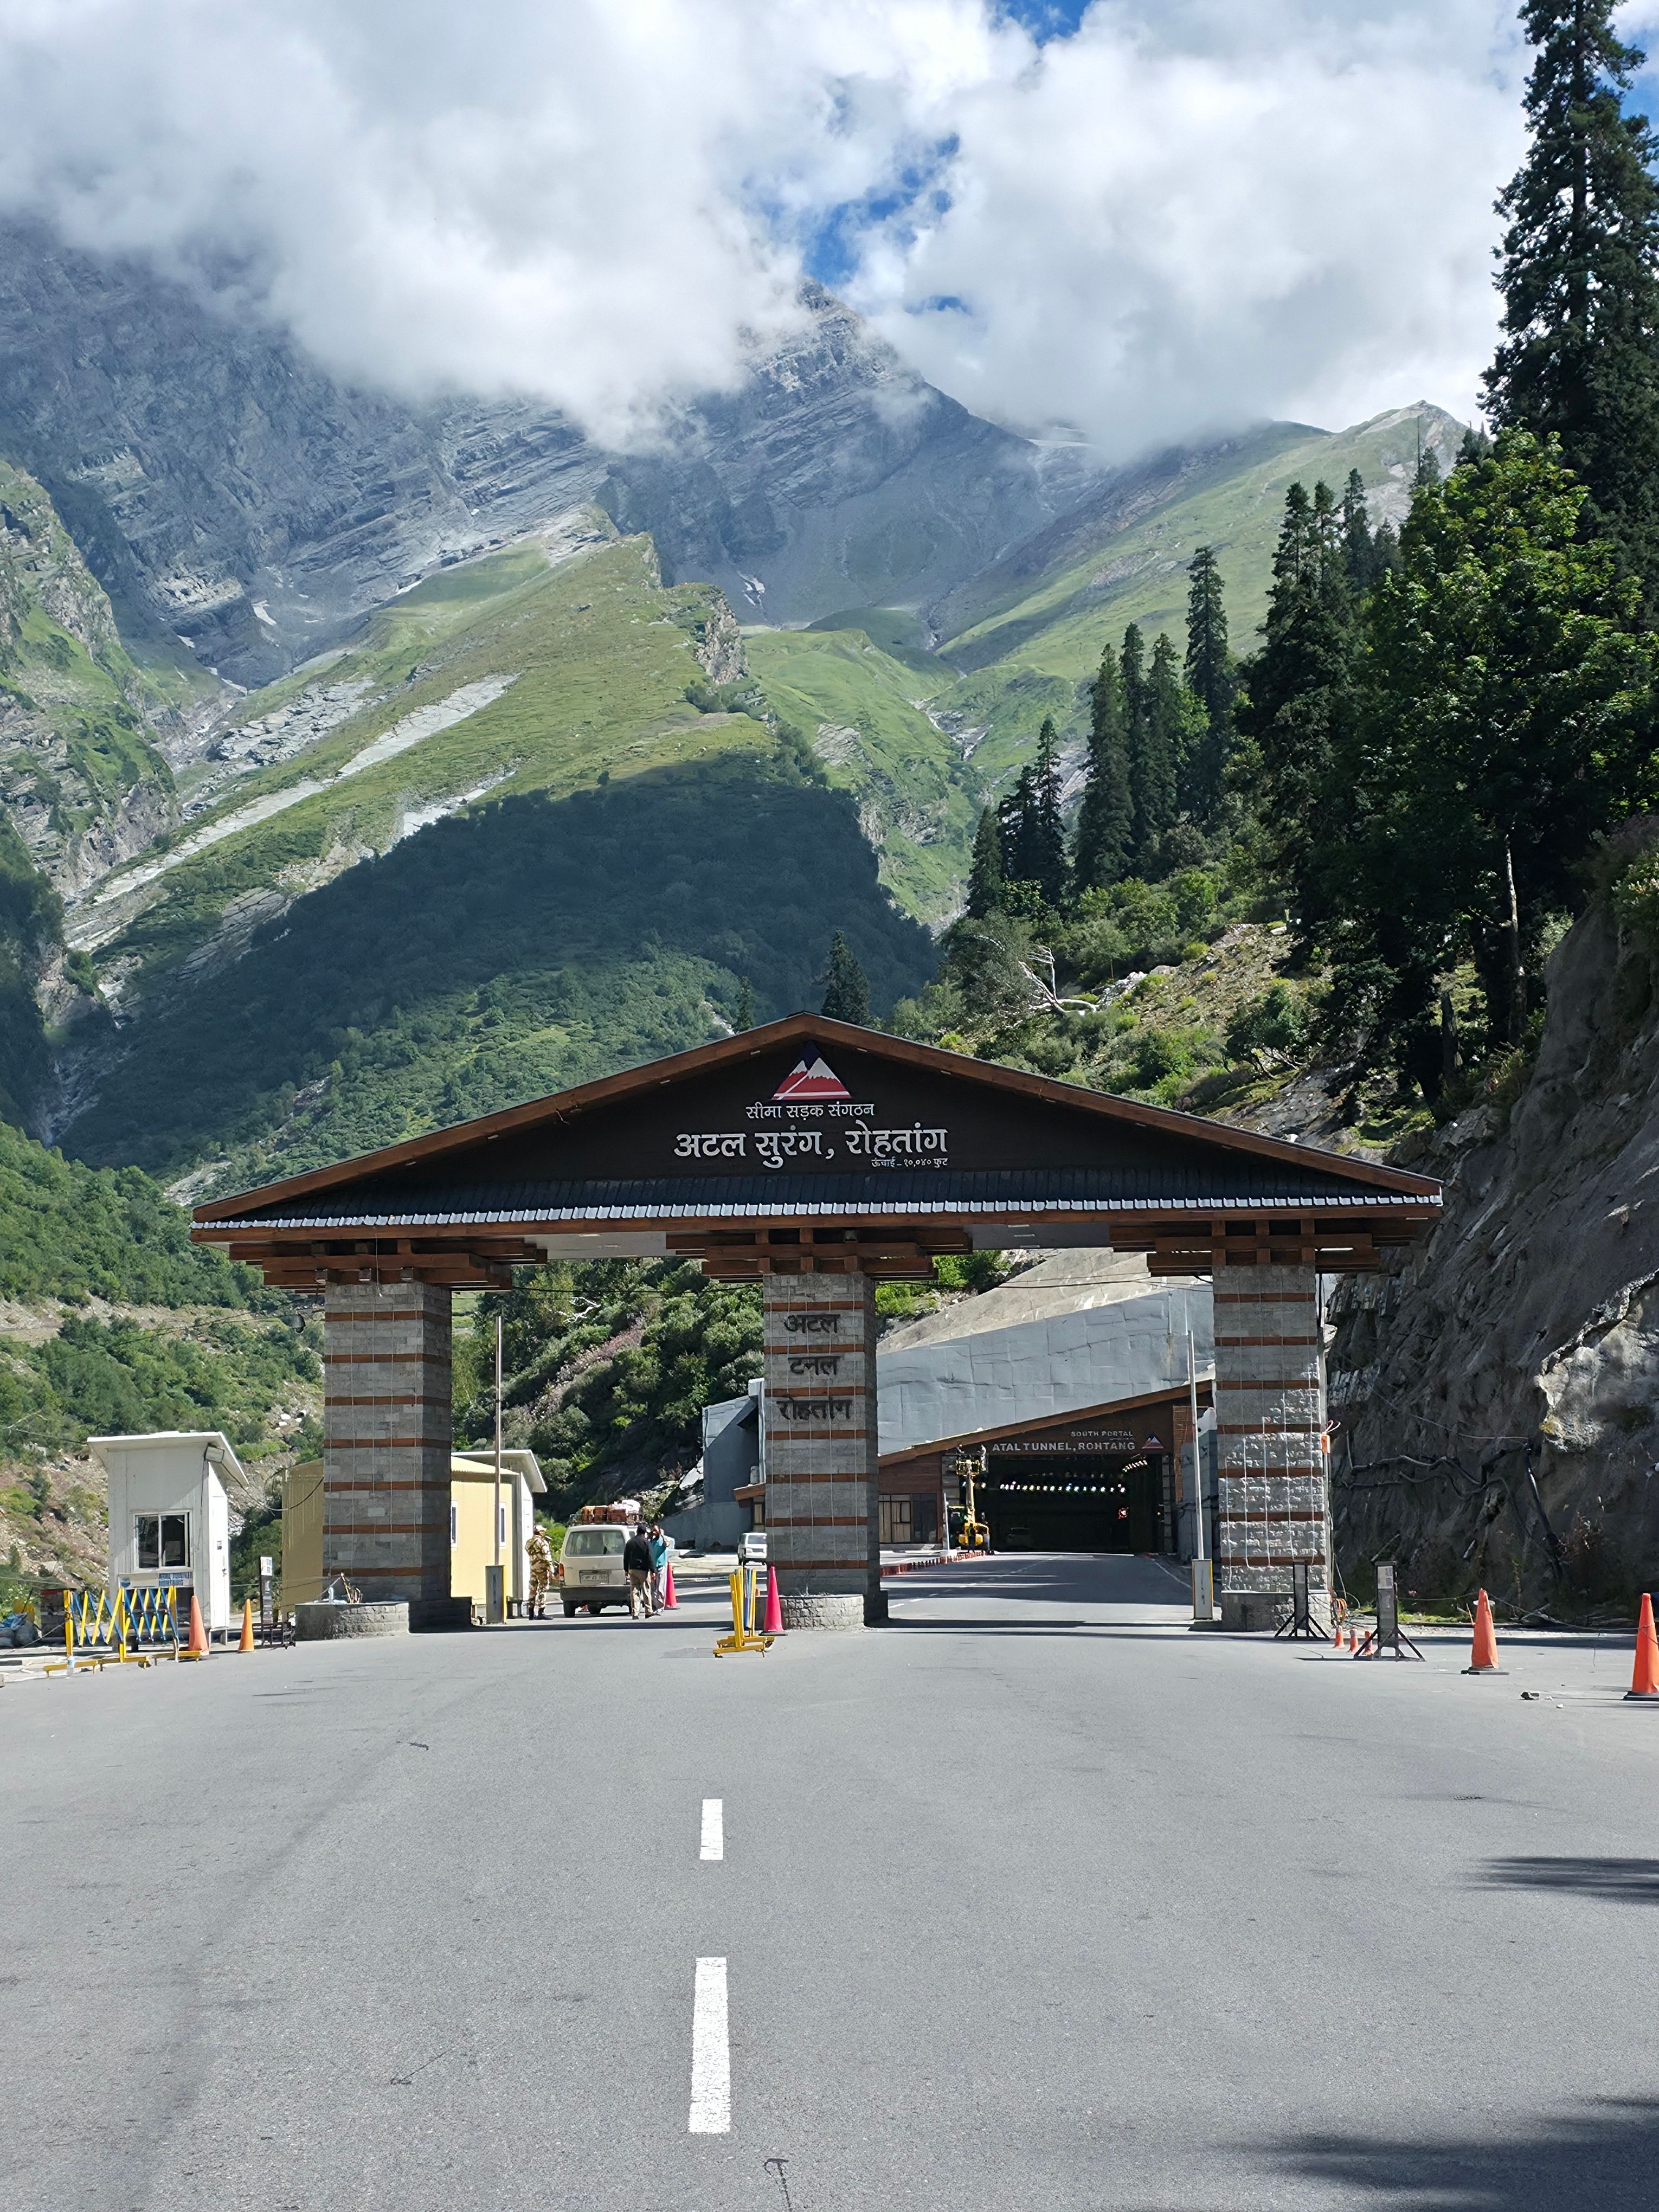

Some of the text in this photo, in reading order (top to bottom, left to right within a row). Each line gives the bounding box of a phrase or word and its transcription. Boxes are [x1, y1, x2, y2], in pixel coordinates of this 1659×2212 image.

[745, 1101, 874, 1121] सीमा सड़क संगठन
[673, 1119, 948, 1169] अटल सुरंग, रोहतांग
[933, 1158, 948, 1168] फुट
[784, 1314, 841, 1334] अटल
[788, 1356, 841, 1375] टनल
[992, 1442, 1136, 1452] ATAL TUNNEL, ROHTANG
